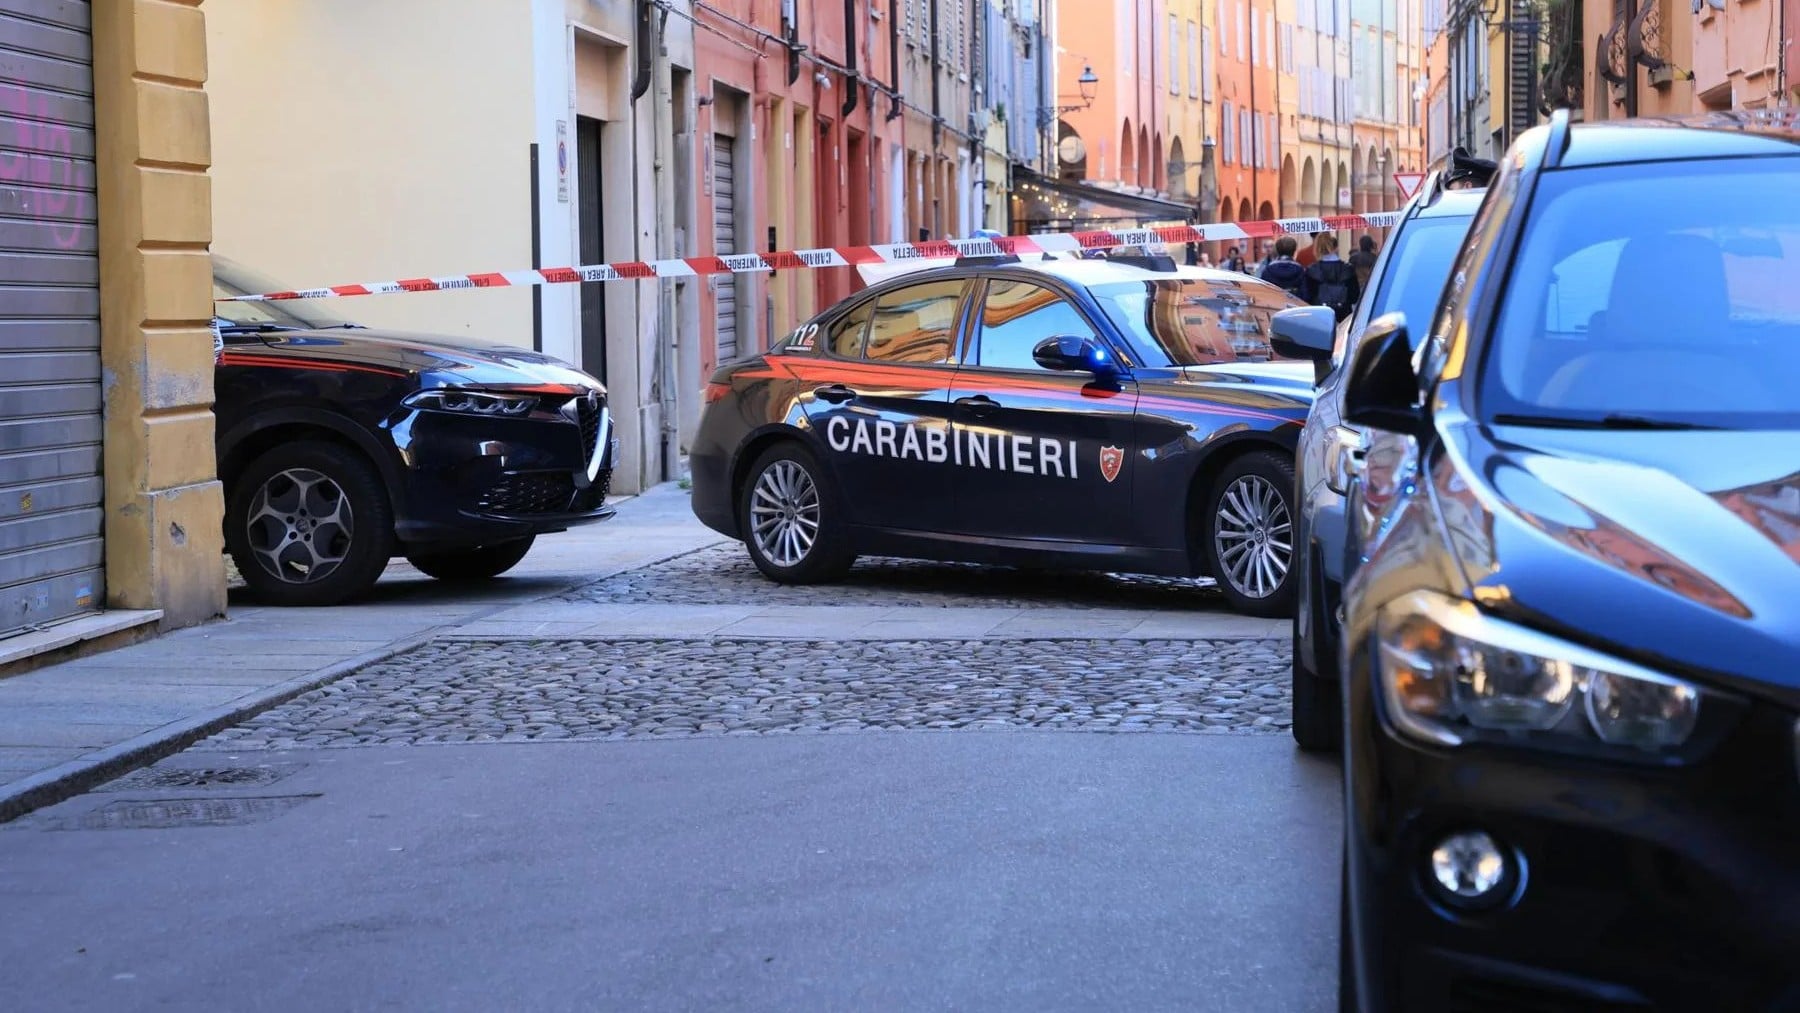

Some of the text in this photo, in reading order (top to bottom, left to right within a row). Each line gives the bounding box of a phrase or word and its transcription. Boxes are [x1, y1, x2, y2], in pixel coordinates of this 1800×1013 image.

[1272, 222, 1318, 234] INTERDETTA
[1321, 219, 1342, 230] AREA
[1079, 229, 1205, 248] CARABINIERI AREA INTERDETTA
[893, 240, 1015, 259] CARABINIERI AREA INTERDETTA
[715, 252, 832, 270] CARABINIERI AREA INTERDETTA
[545, 264, 657, 283] CARABINIERI AREA INTERDETTA
[790, 323, 819, 346] 112
[827, 415, 1078, 479] CARABINIERI
